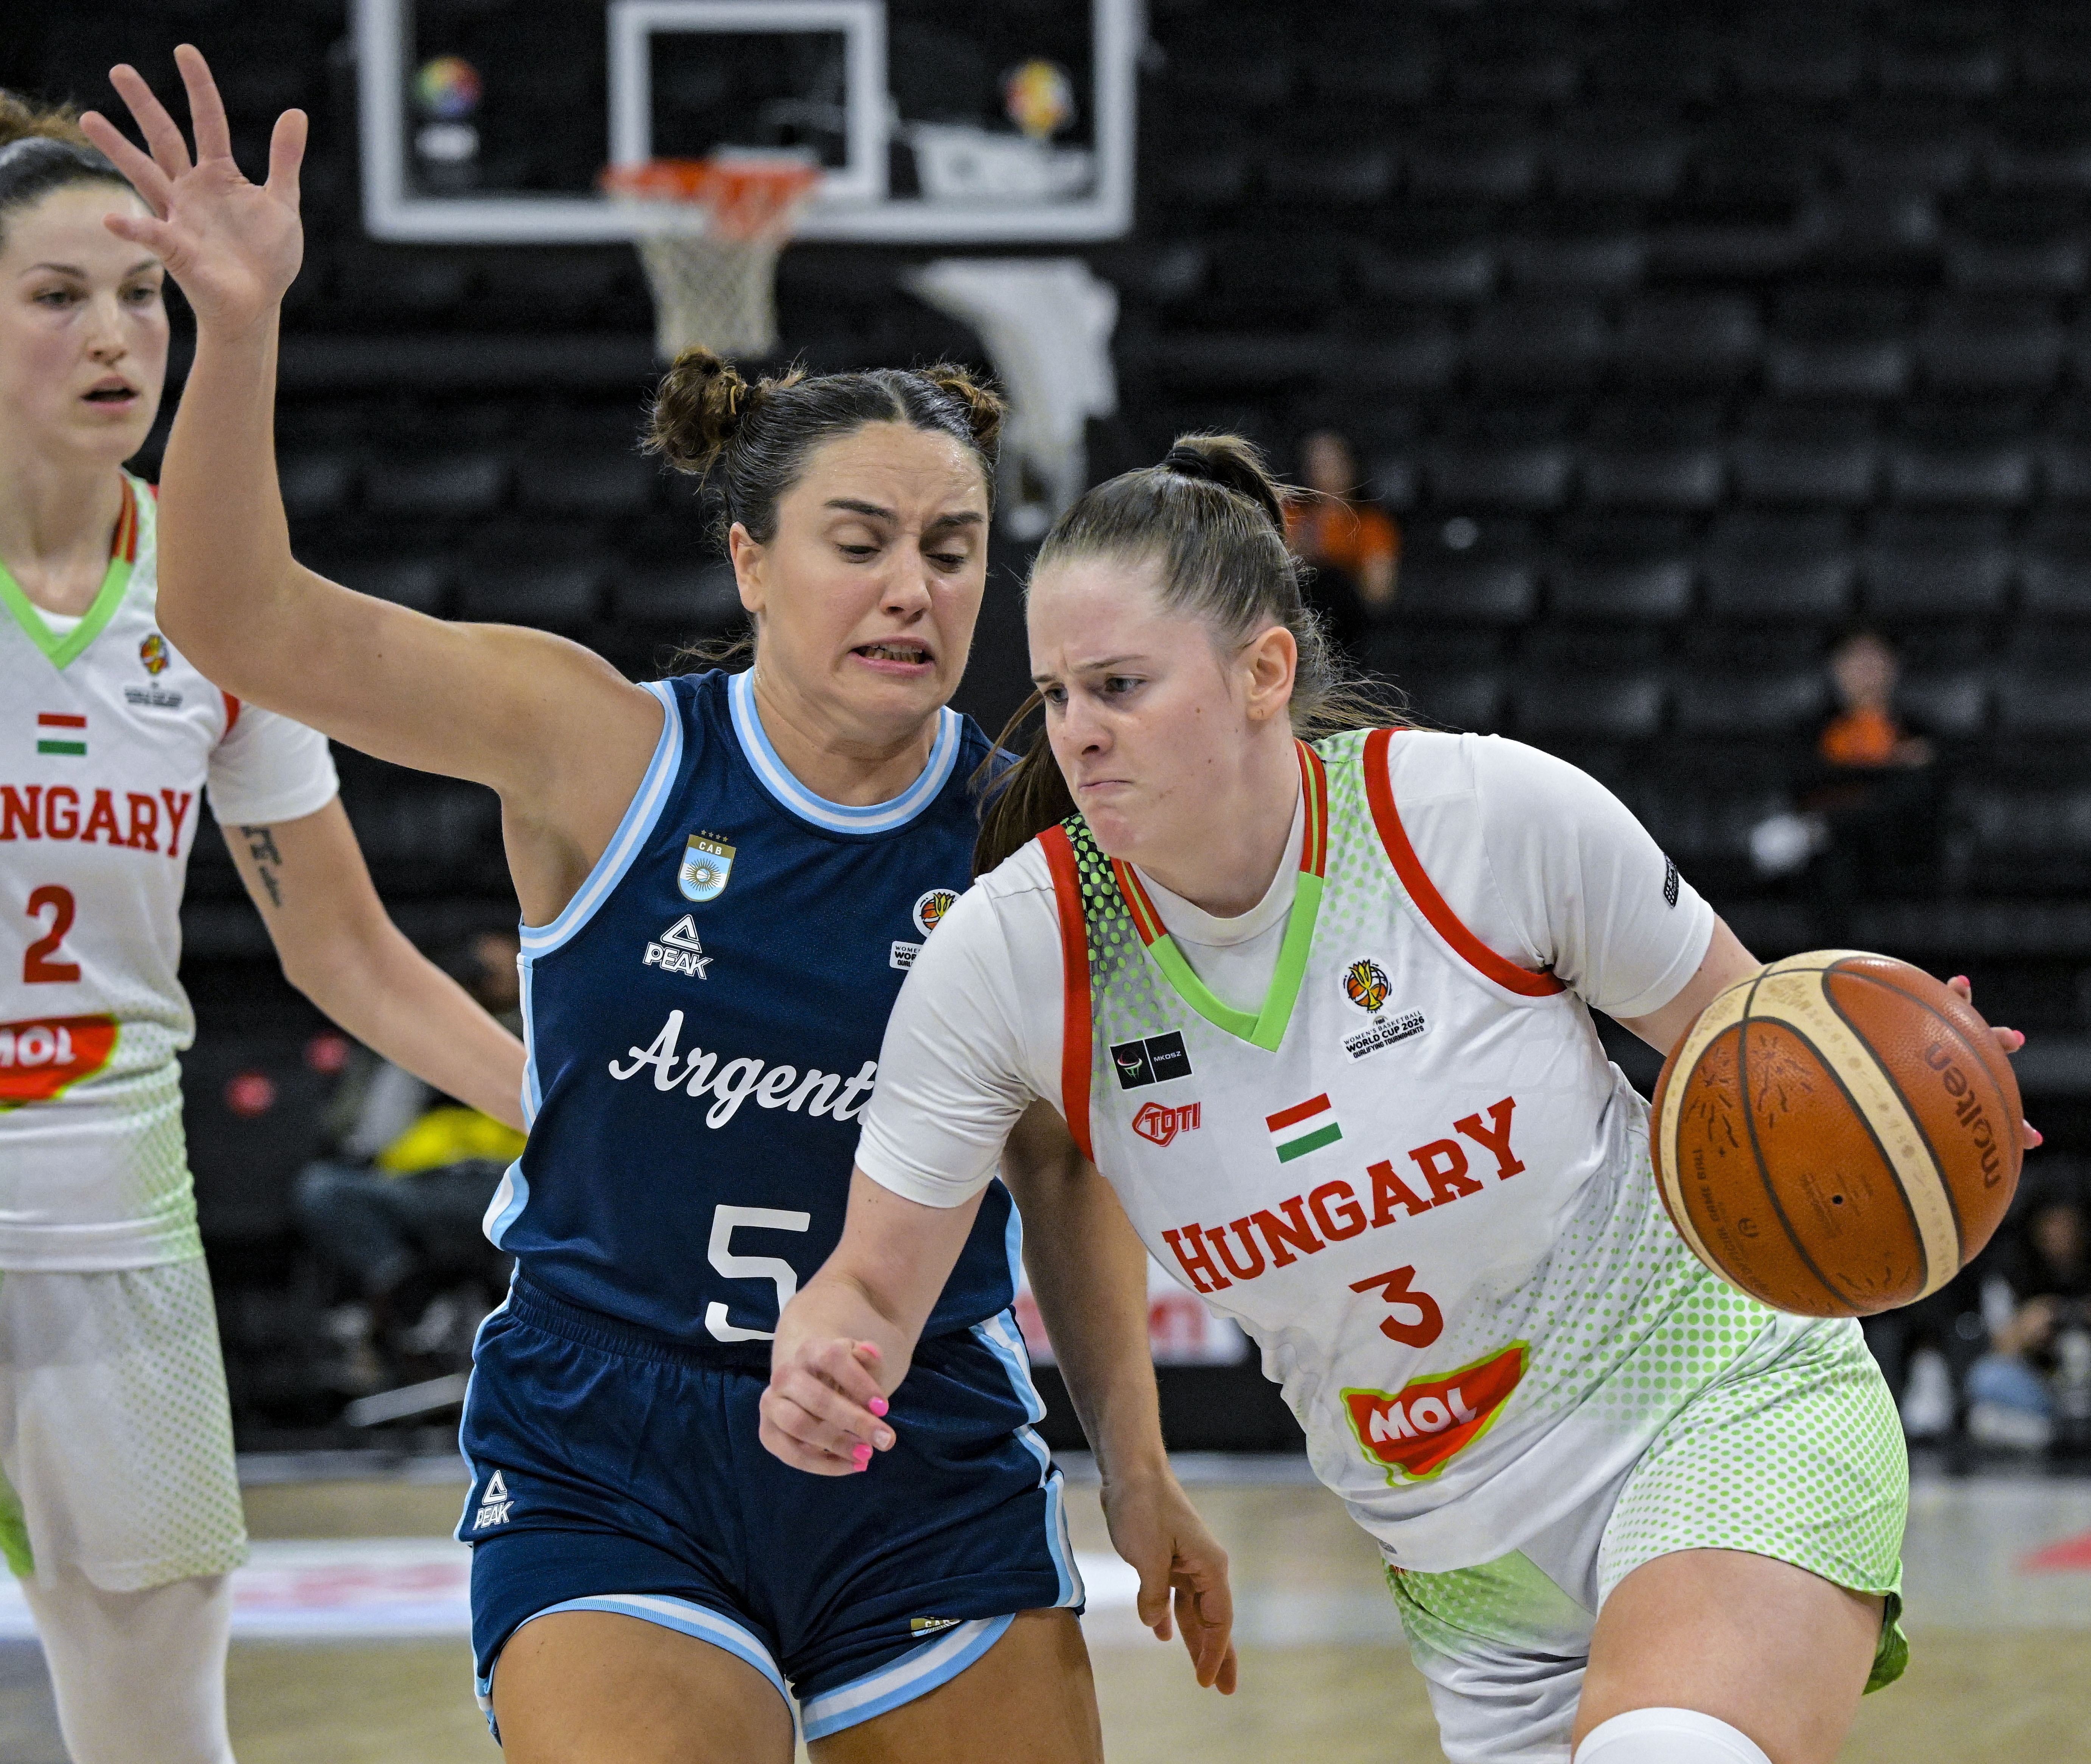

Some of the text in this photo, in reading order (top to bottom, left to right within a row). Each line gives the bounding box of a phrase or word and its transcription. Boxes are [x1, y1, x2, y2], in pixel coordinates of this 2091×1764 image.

[699, 842, 722, 855] CAB
[23, 884, 81, 983] 2
[643, 941, 713, 980] PEAK
[1344, 1010, 1422, 1045] WOMEN'S BASKETBALL
[1346, 1016, 1425, 1053] WORLD CUP 2026
[1353, 1025, 1424, 1058] QUALIFYING TOURNAMENTS
[1153, 1051, 1181, 1062] MKOSZ
[1145, 1102, 1201, 1137] TOTI
[1925, 1043, 2002, 1189] molten
[1162, 1096, 1525, 1293] HUNGARY
[705, 1204, 810, 1342] 5
[1348, 1265, 1443, 1348] 3
[1369, 1387, 1477, 1443] MOL
[473, 1501, 514, 1530] PEAK
